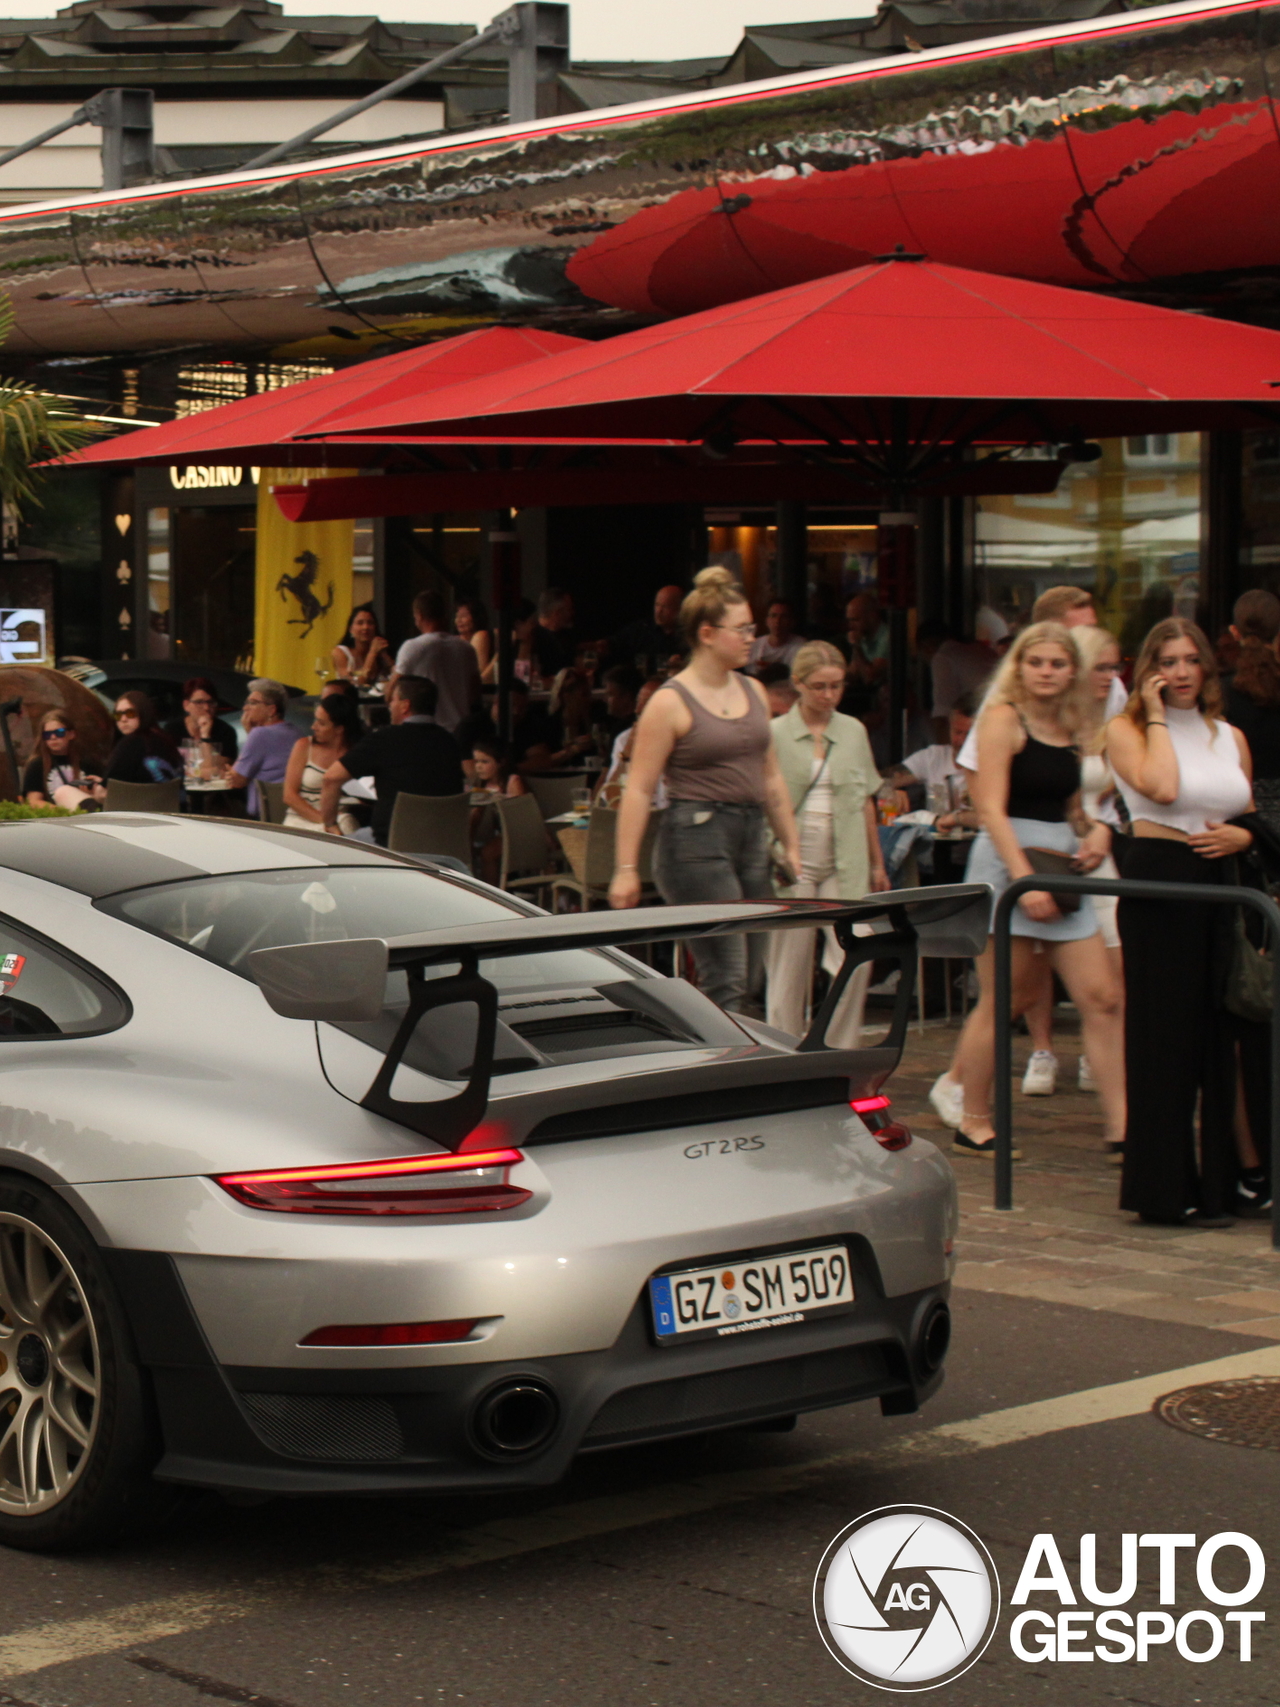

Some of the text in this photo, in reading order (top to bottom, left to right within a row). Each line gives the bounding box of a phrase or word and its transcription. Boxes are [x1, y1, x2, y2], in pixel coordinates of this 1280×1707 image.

[675, 1254, 846, 1324] GZ SM 509
[661, 1312, 670, 1325] D
